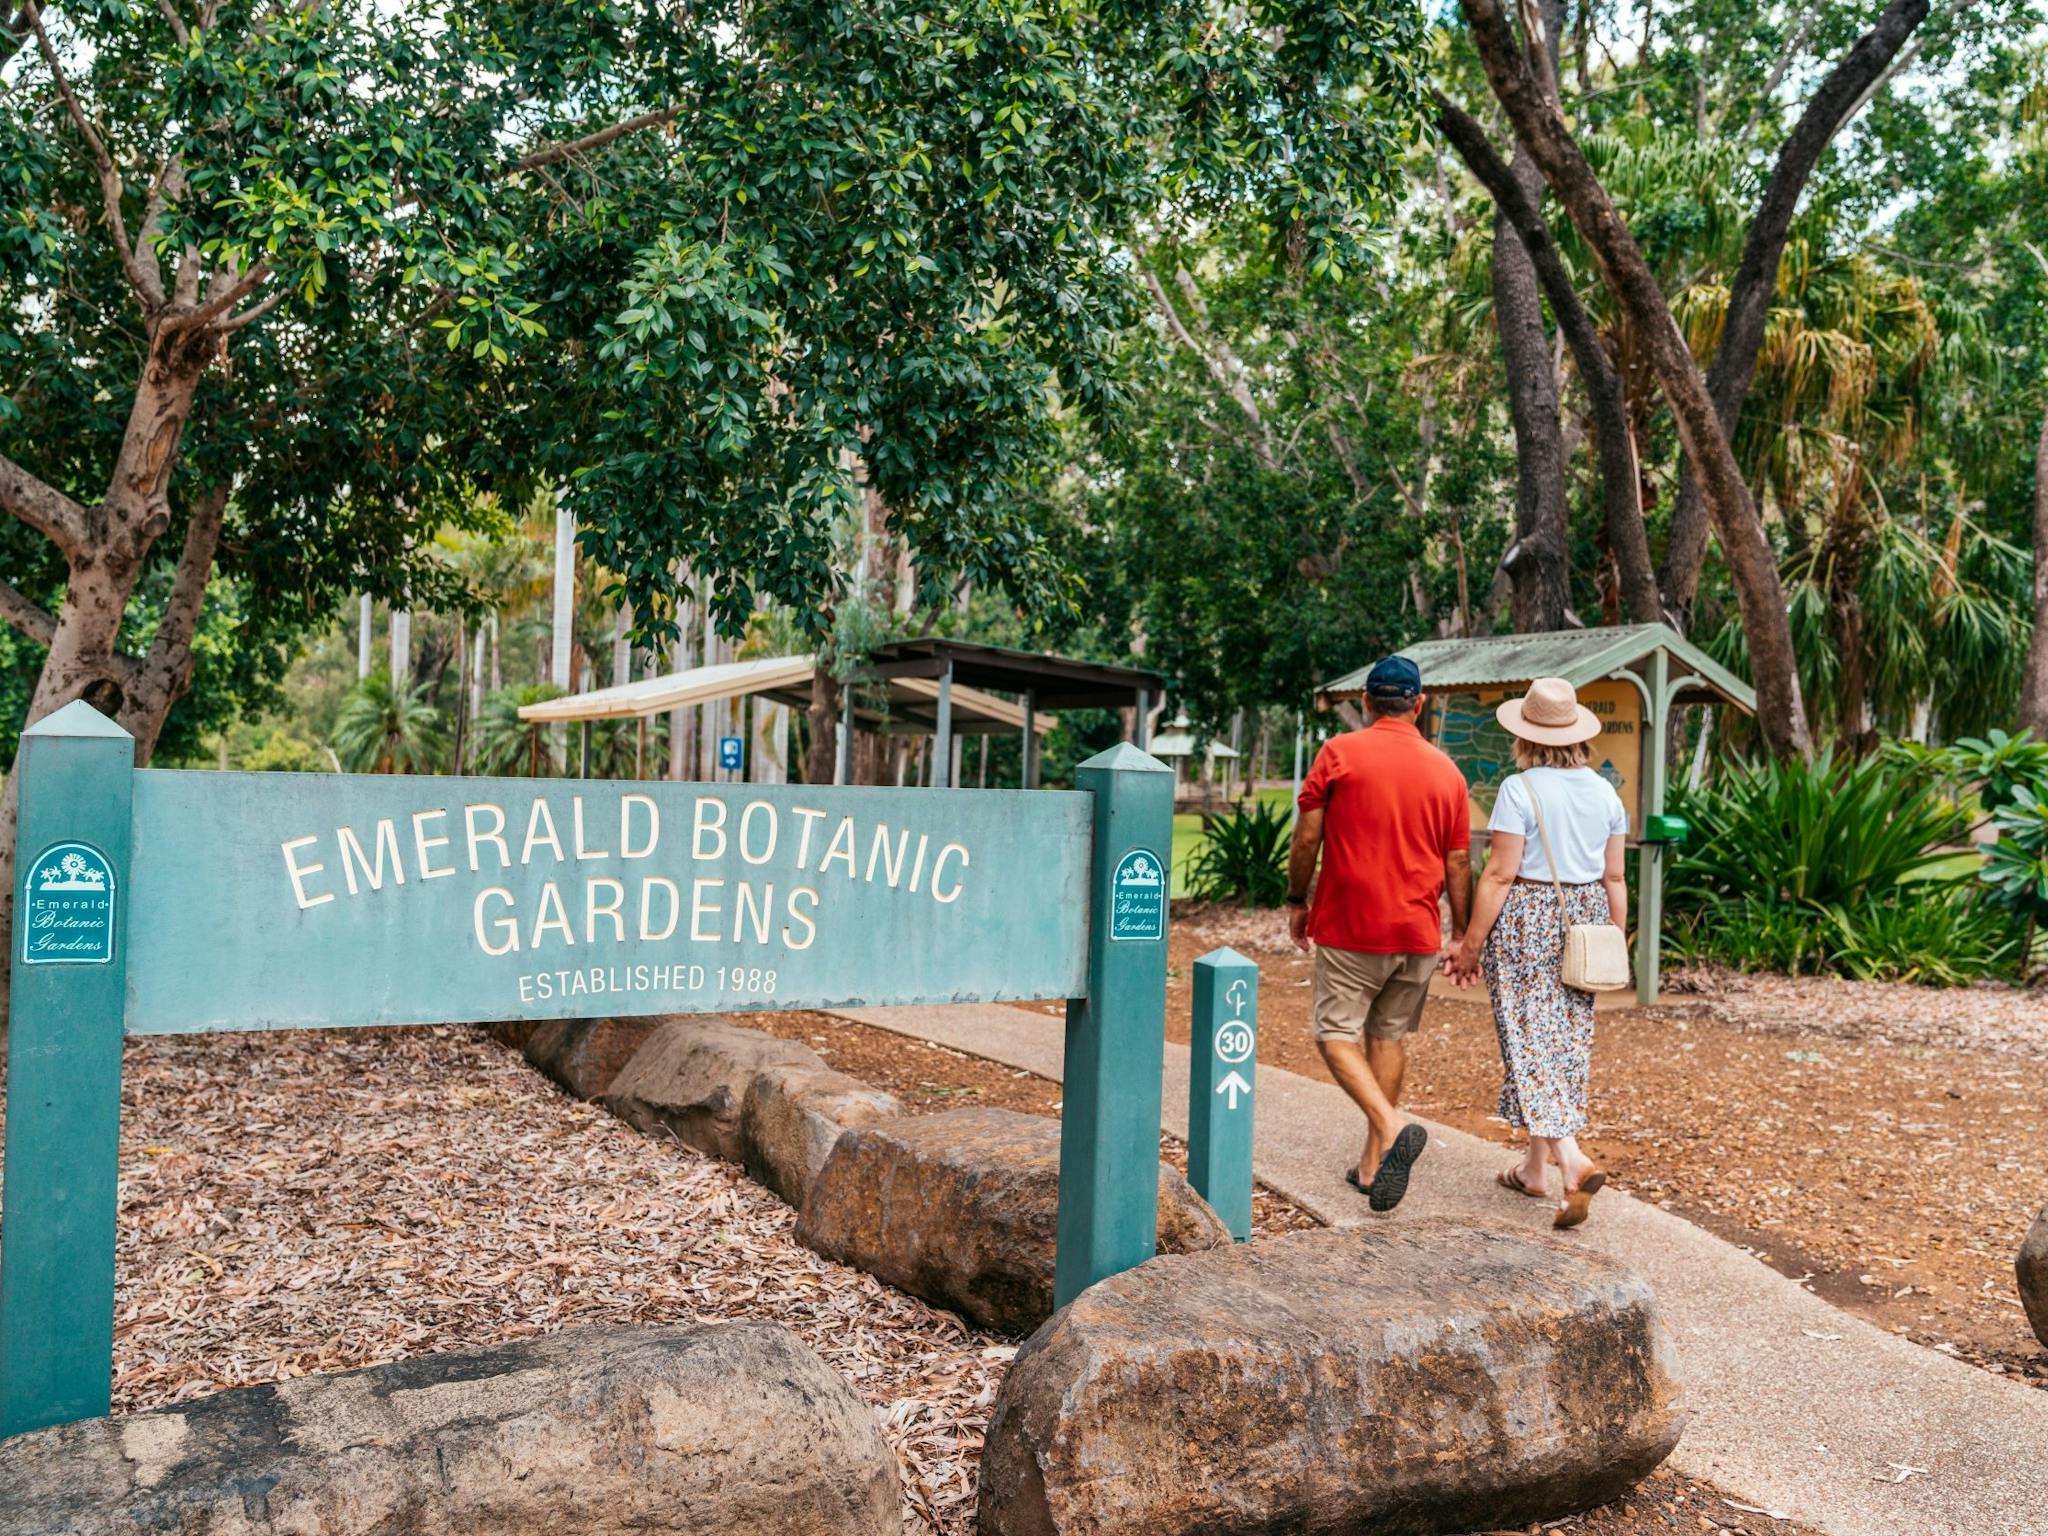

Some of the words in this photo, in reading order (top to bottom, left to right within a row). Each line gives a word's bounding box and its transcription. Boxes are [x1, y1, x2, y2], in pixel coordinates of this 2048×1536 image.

[1582, 700, 1616, 714] ERALD
[281, 793, 661, 910] EMERALD
[691, 795, 971, 904] BOTANIC
[473, 876, 820, 957] GARDENS
[1116, 900, 1158, 914] Botanic
[32, 909, 105, 929] Botanic
[1114, 917, 1157, 931] Gardens
[30, 932, 103, 951] Gardens
[518, 965, 705, 1002] ESTABLISHED
[716, 966, 777, 995] 1988
[1221, 1031, 1248, 1054] 30
